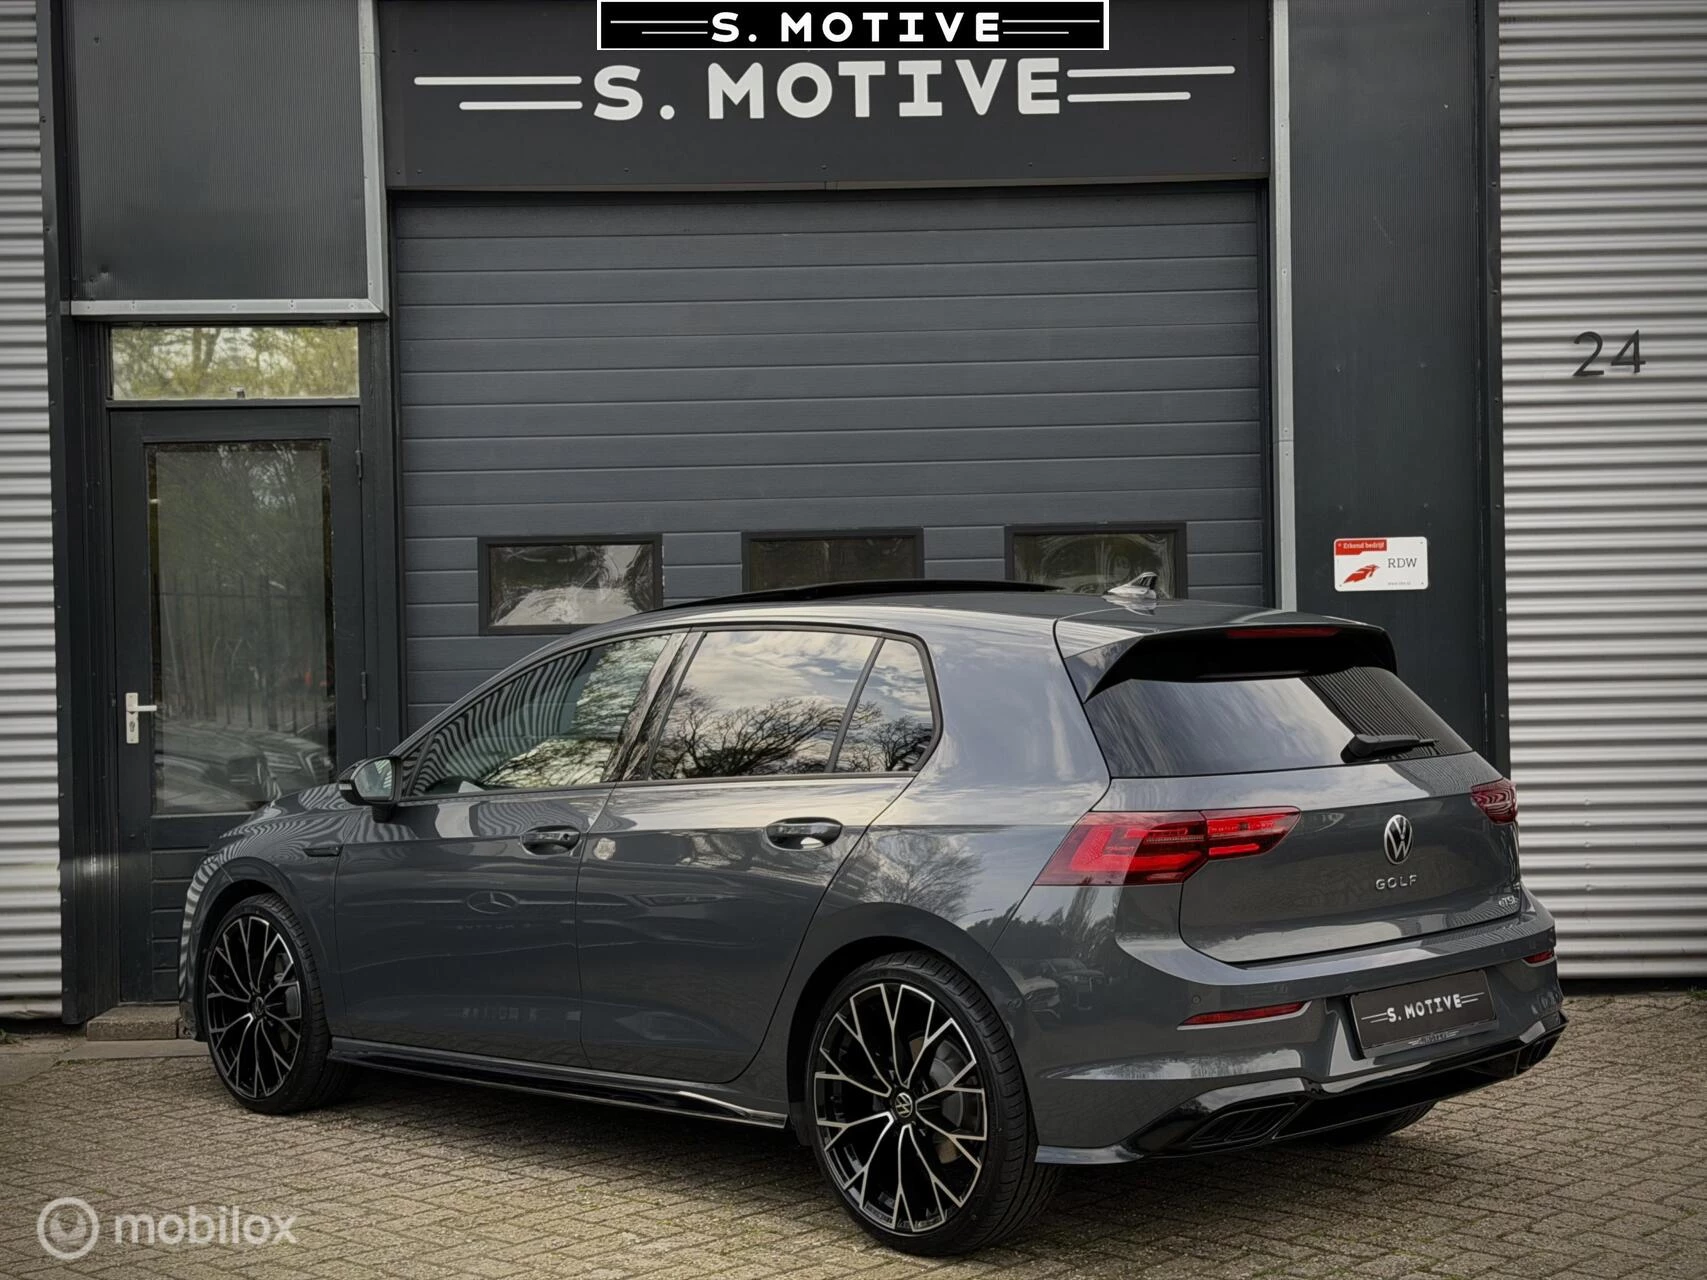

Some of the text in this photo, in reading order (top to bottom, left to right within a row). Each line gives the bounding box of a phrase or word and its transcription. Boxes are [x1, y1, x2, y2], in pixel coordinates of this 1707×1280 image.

[593, 57, 1060, 121] S. MOTIVE
[1572, 328, 1647, 377] 24
[1387, 557, 1418, 569] RDW
[1375, 874, 1417, 890] GOLF
[1386, 993, 1463, 1023] S. MOTIVE
